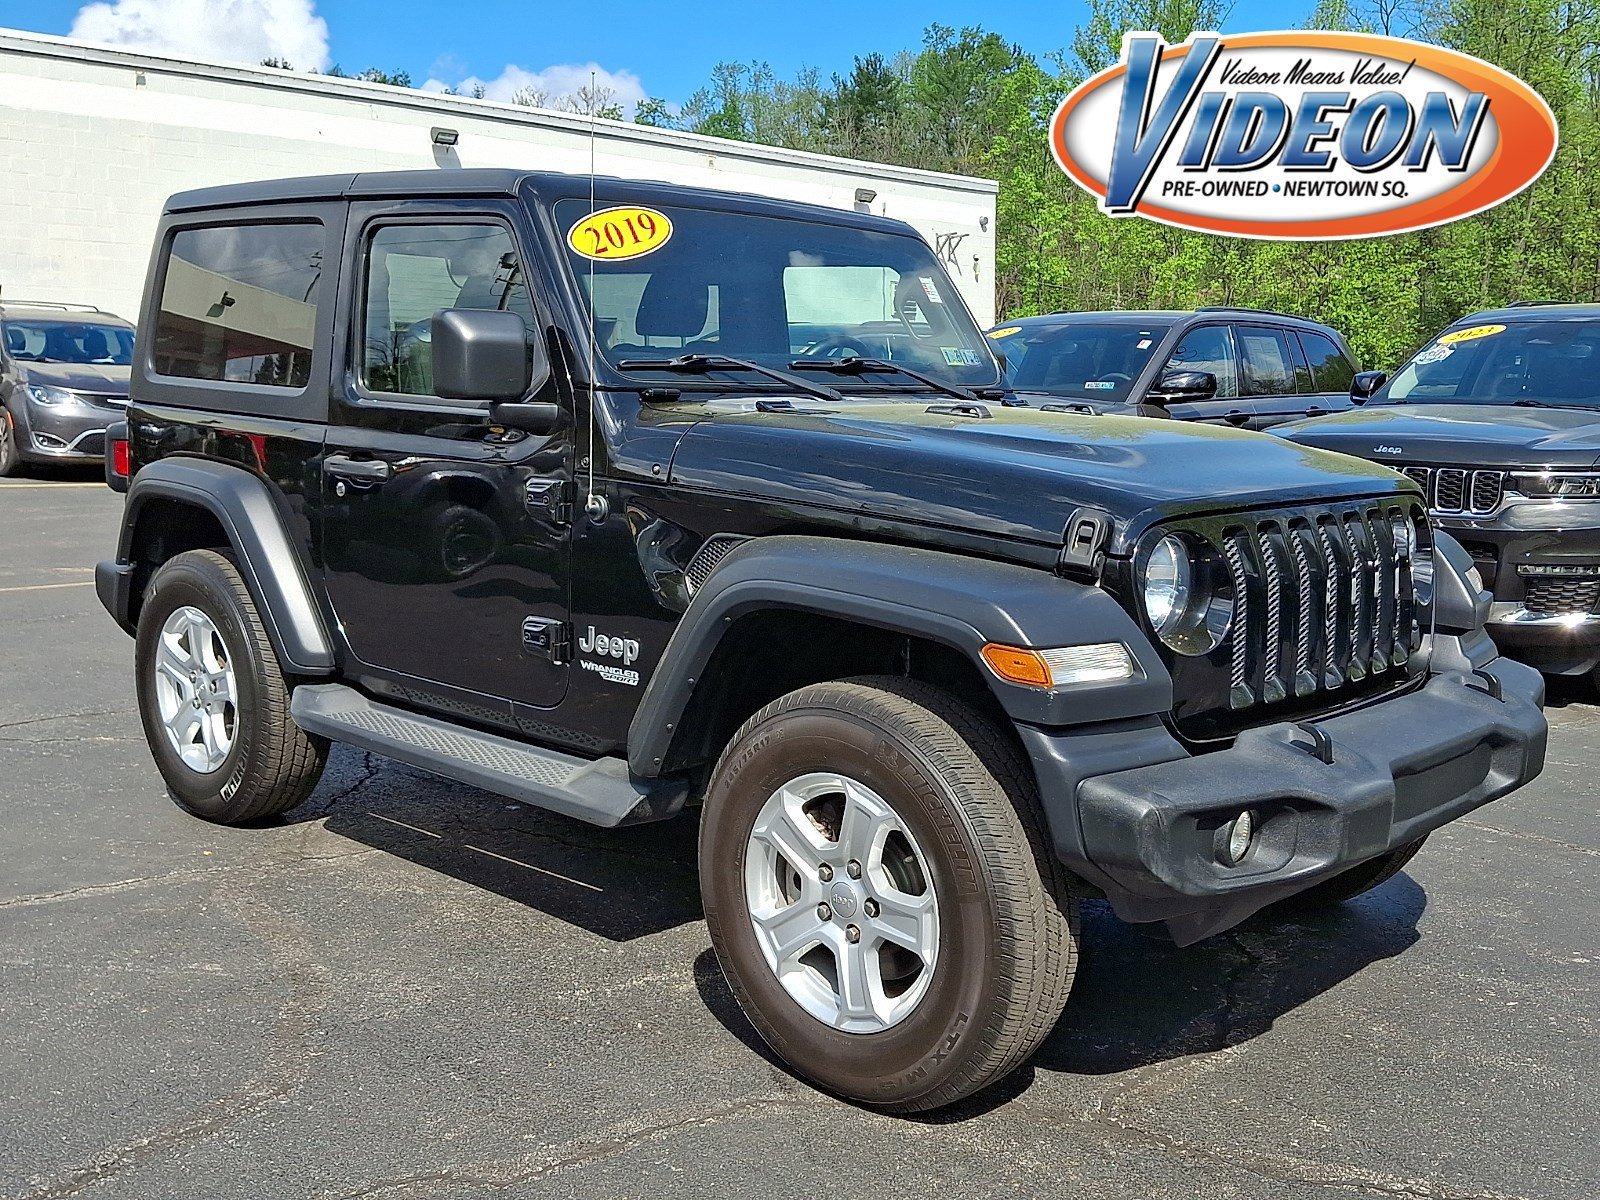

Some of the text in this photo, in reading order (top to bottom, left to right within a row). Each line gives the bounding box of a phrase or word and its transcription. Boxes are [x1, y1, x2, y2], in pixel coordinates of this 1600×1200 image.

[584, 213, 657, 255] 2019
[1373, 445, 1402, 455] Jeep
[579, 625, 639, 665] Jeep
[580, 660, 640, 679] WRANGLER
[899, 764, 979, 895] MICHELIN
[929, 1011, 969, 1066] LTX
